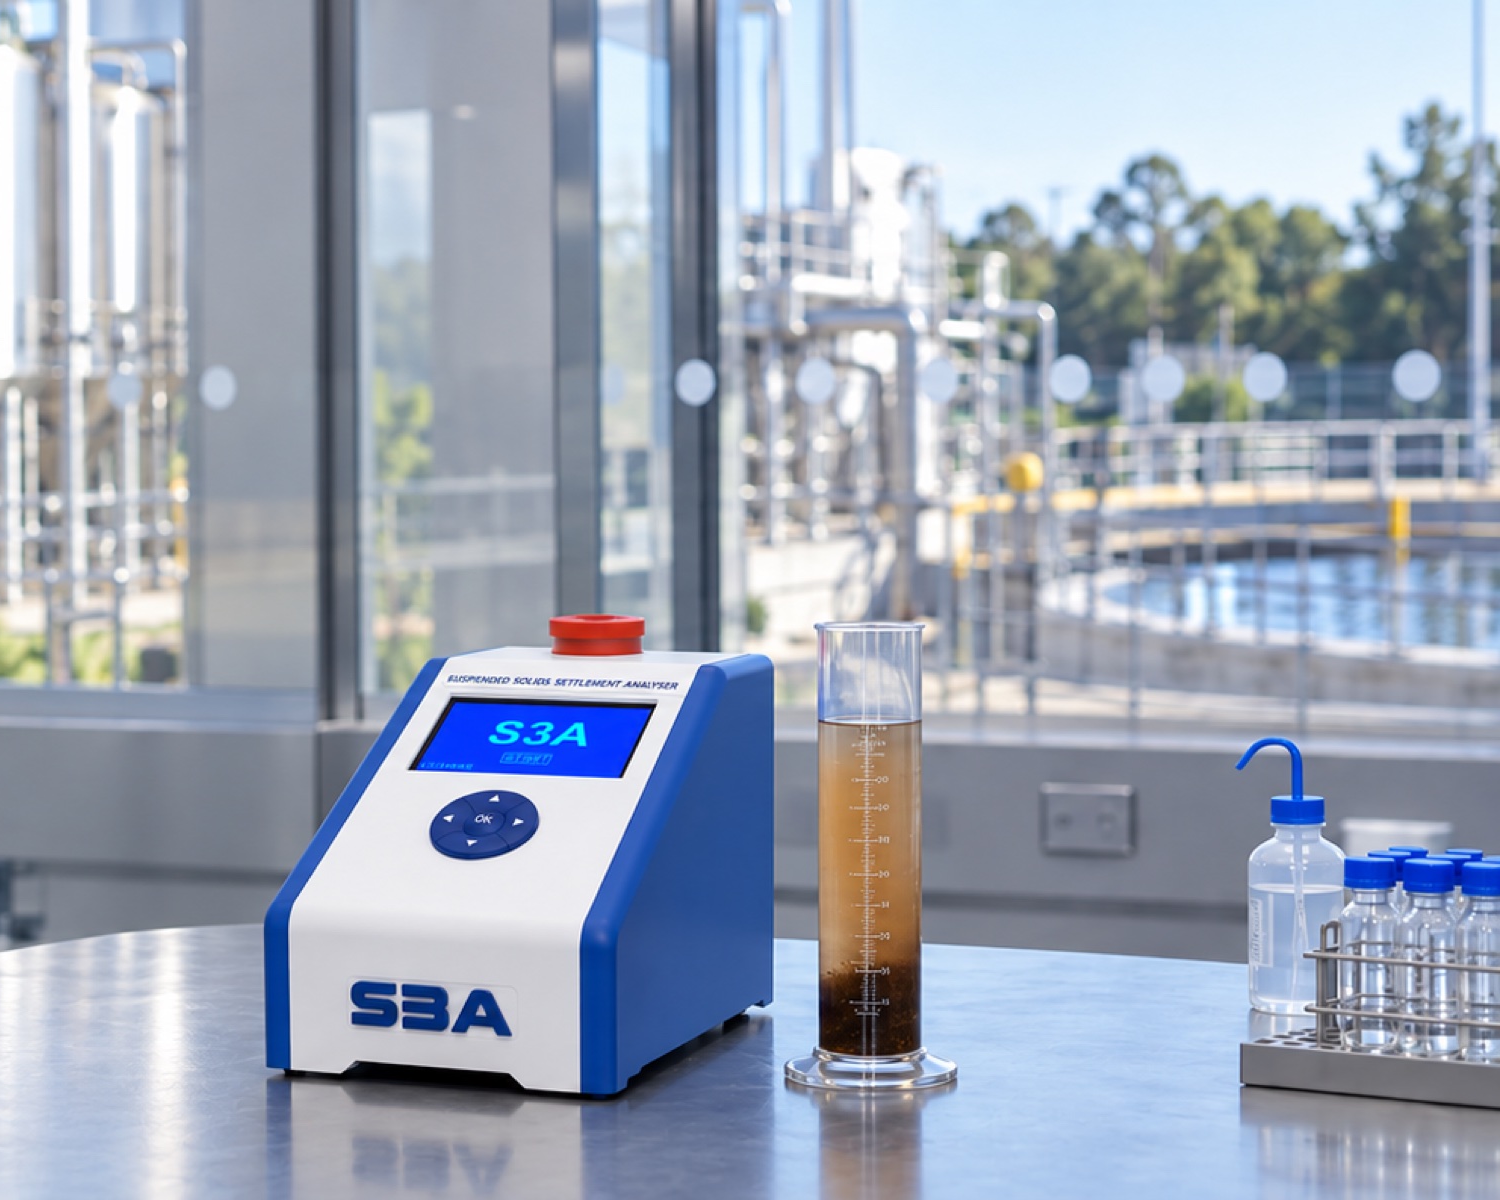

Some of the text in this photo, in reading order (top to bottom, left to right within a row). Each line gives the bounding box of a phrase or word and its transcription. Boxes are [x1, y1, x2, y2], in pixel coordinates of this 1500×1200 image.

[554, 678, 623, 688] SETTLEMENT
[623, 680, 679, 690] ANALYSER
[488, 720, 587, 747] S3A
[475, 813, 494, 824] OK
